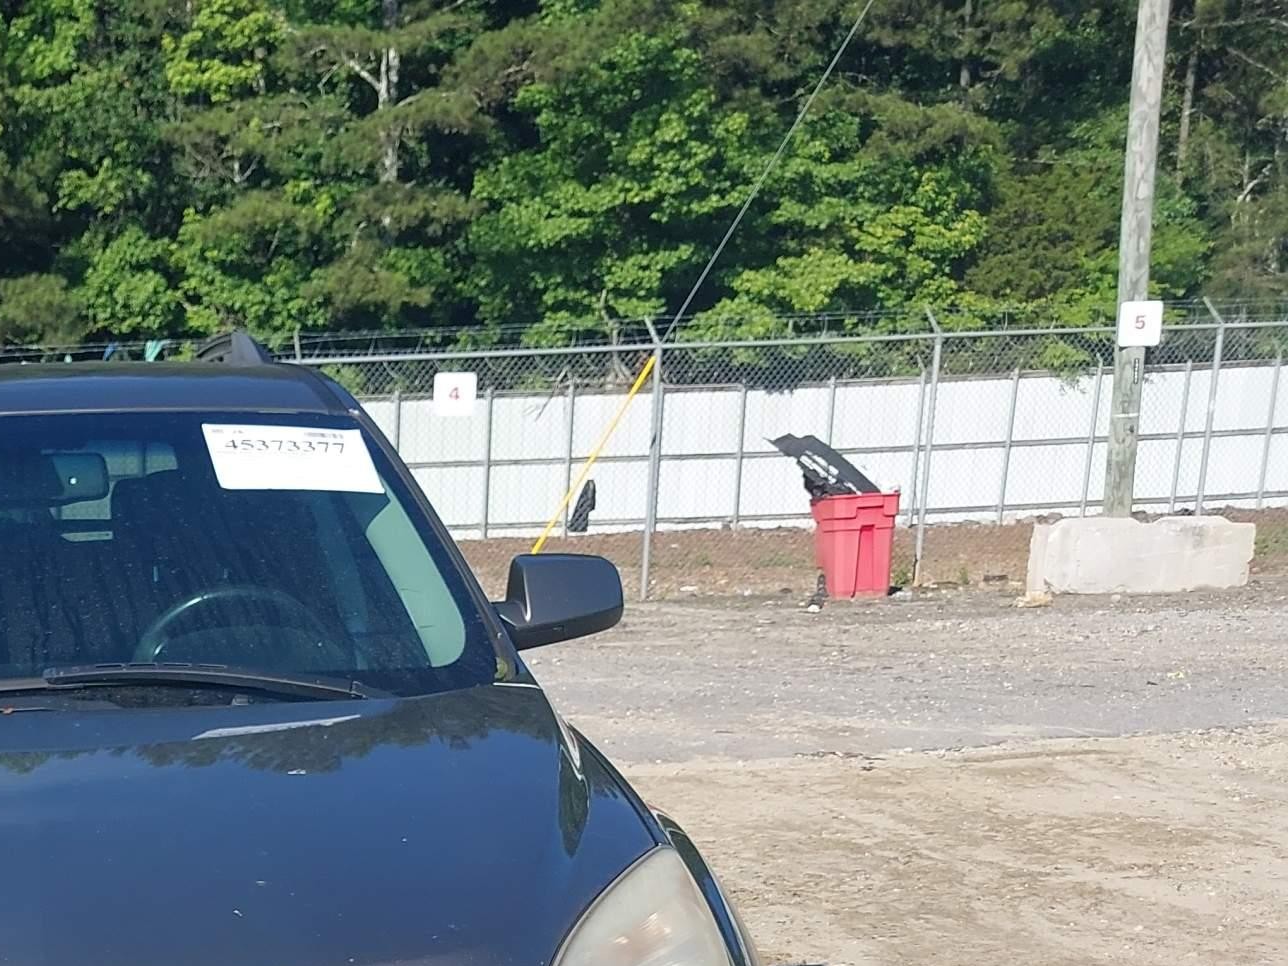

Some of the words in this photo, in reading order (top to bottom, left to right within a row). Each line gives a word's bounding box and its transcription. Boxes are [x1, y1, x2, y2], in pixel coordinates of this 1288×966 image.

[1135, 315, 1146, 330] 5
[449, 387, 459, 400] 4
[225, 439, 345, 454] 45373377
